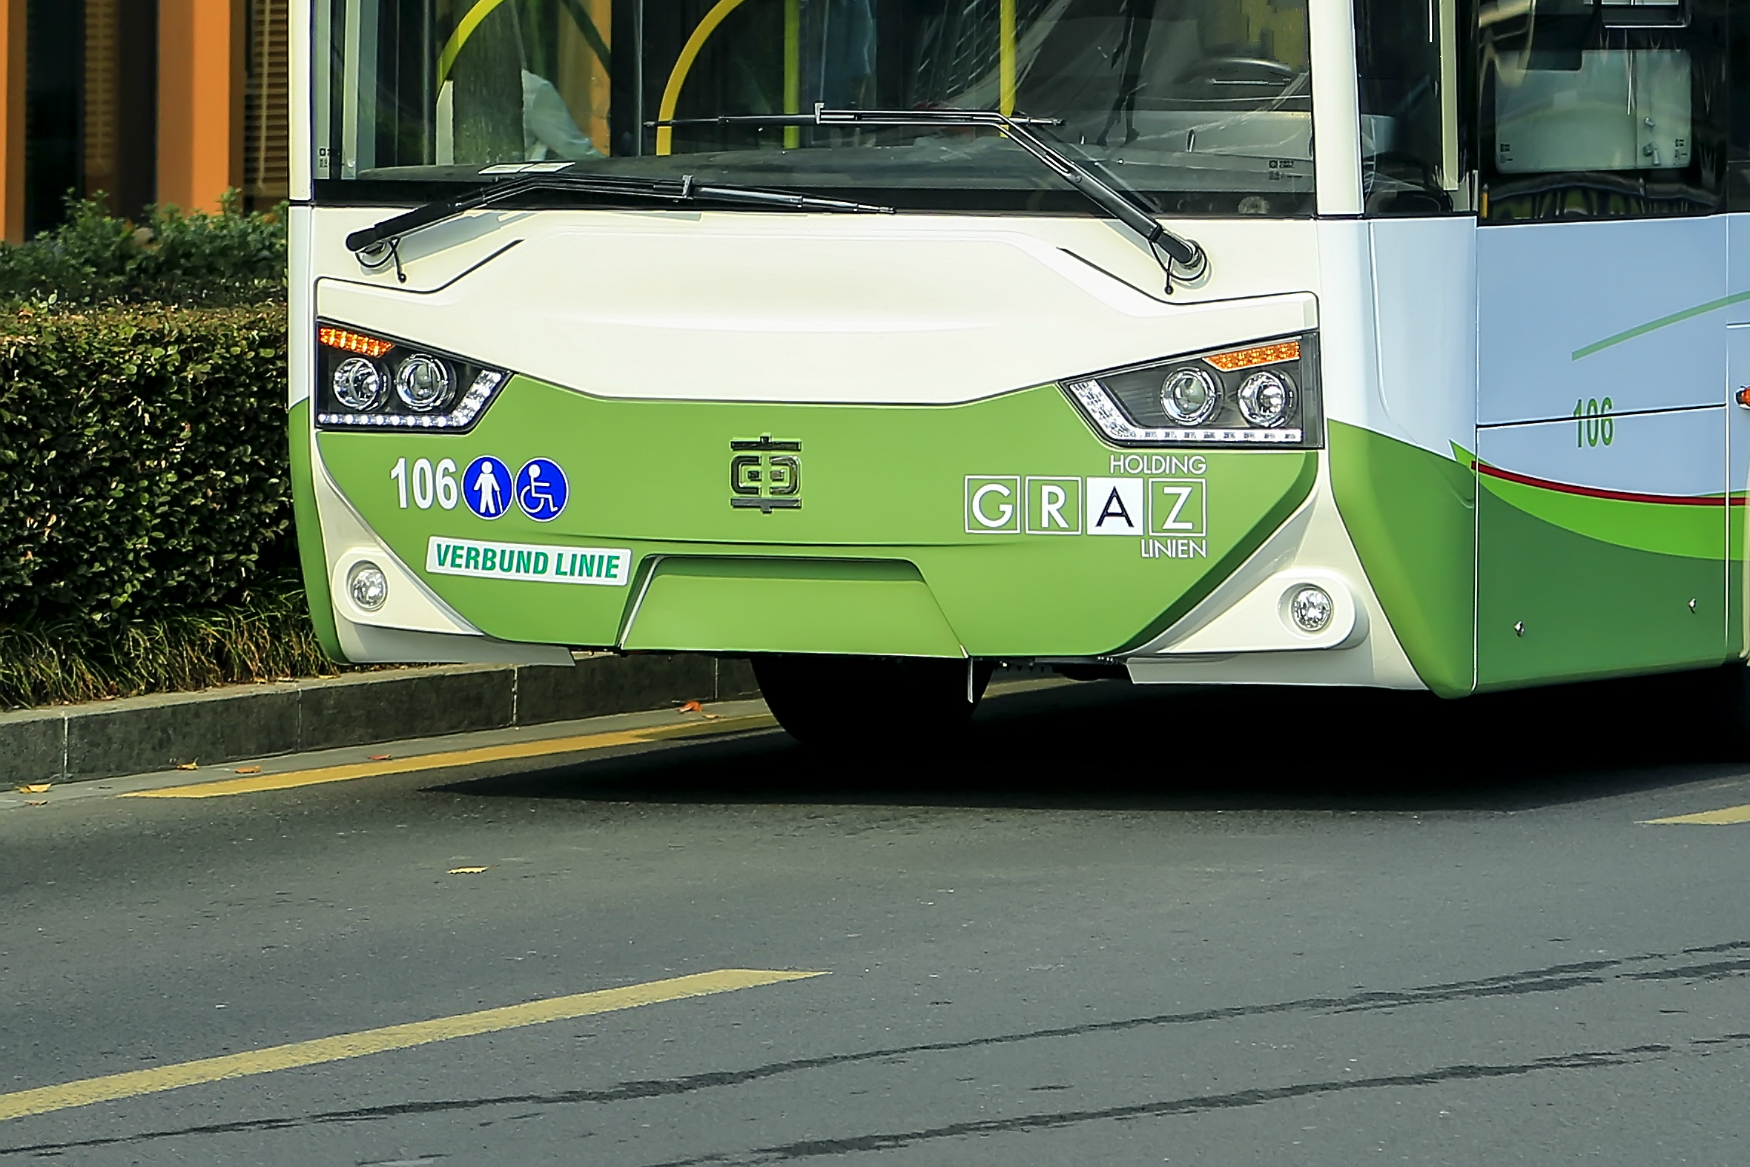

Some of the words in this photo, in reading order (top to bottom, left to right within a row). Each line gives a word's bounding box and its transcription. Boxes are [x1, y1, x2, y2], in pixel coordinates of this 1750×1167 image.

[1573, 397, 1613, 448] 106
[390, 457, 459, 510] 106
[1110, 454, 1207, 475] HOLDING
[972, 482, 1194, 531] GRAZ
[436, 542, 550, 576] VERBUND
[554, 551, 621, 579] LINIE
[1141, 538, 1207, 559] LINIEN
